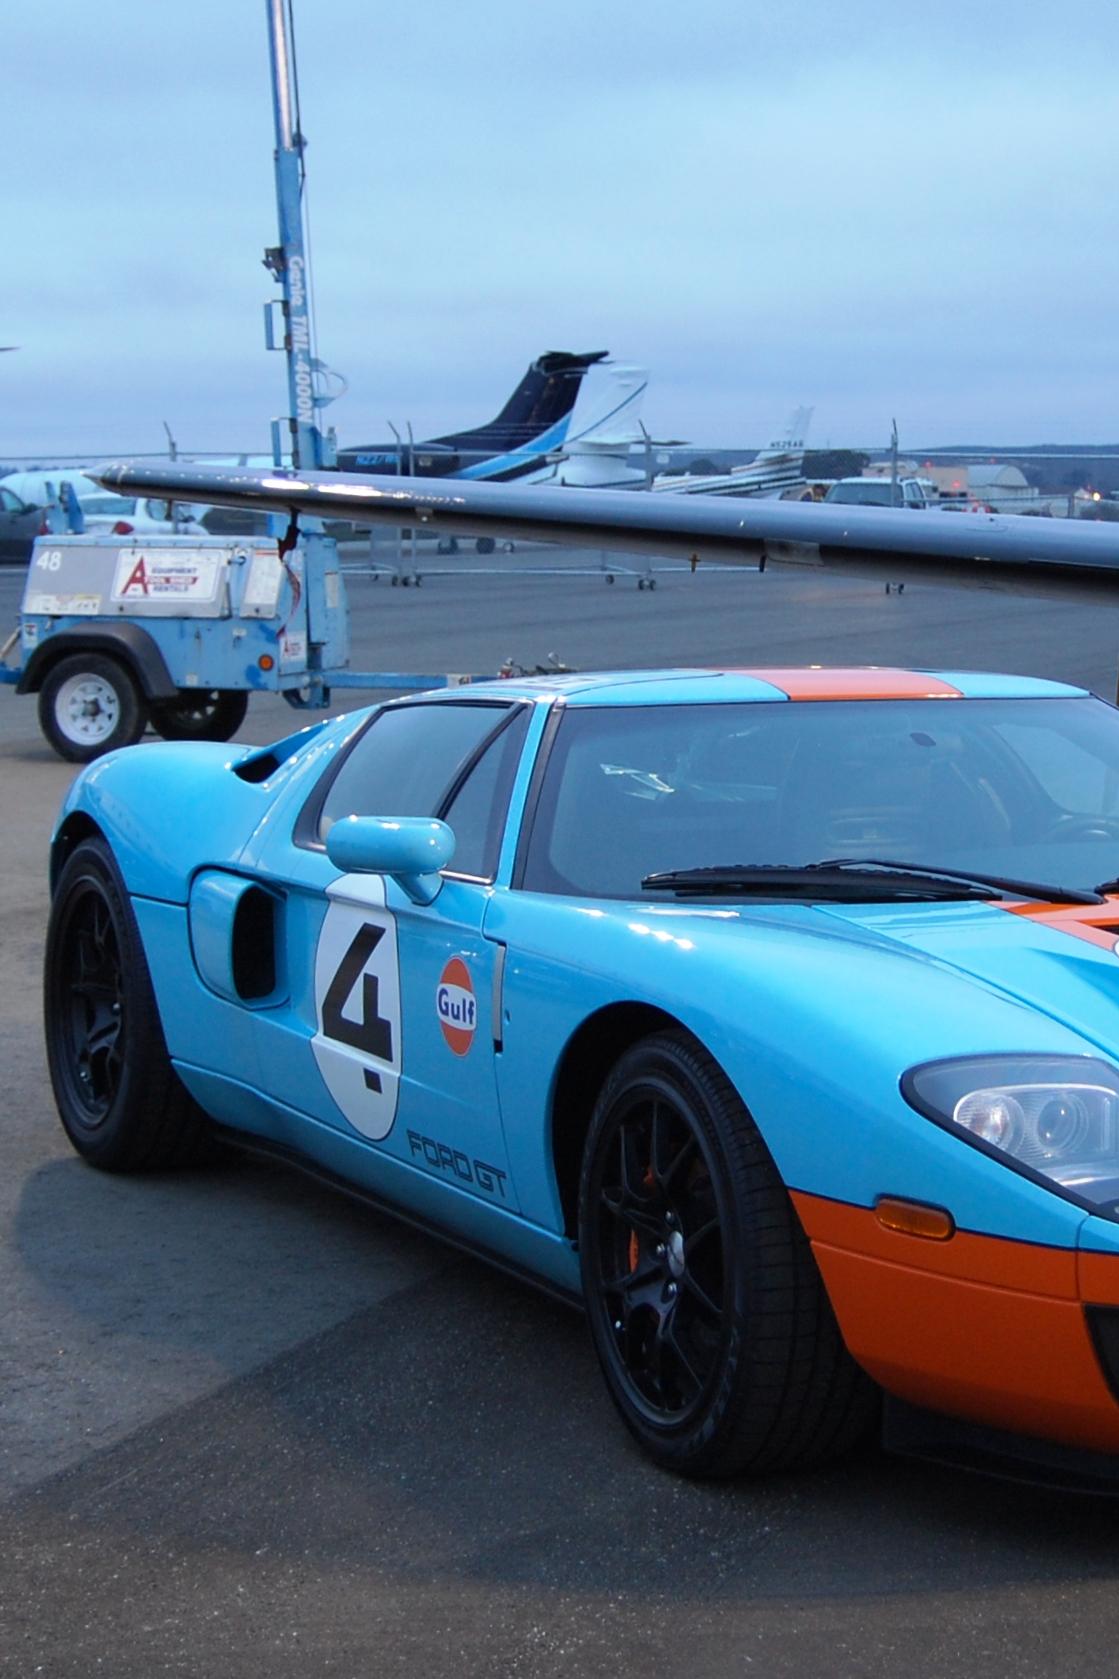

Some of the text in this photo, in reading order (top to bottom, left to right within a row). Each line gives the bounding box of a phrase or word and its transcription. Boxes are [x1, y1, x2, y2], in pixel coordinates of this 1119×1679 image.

[288, 256, 313, 423] Genie TML-4000N
[36, 551, 62, 571] 48
[121, 555, 149, 595] A
[322, 922, 394, 1094] 4
[438, 987, 475, 1026] Gulf
[406, 1128, 508, 1199] FORD GT
